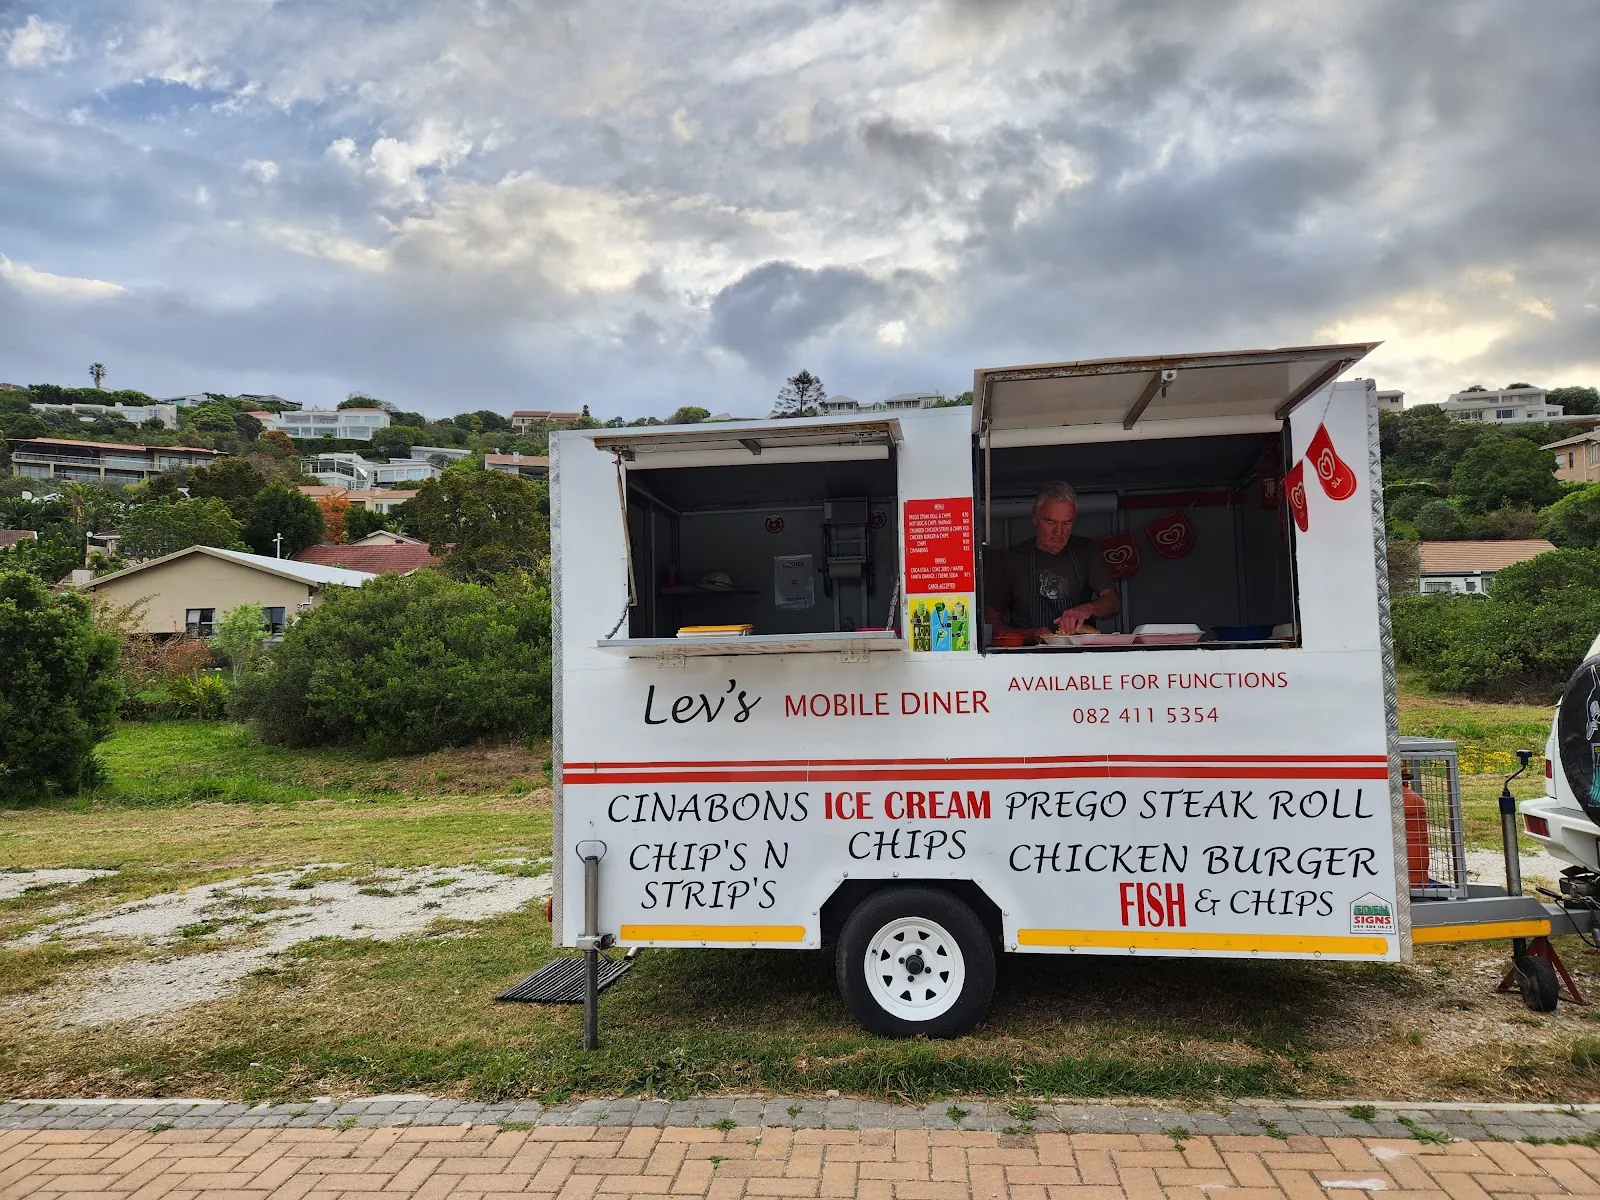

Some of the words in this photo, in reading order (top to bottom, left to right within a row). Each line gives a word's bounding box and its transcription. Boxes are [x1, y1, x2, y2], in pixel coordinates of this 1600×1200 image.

[1331, 477, 1342, 488] OLA
[1171, 542, 1184, 551] OLA
[1008, 674, 1113, 692] AVAILABLE
[1121, 674, 1160, 690] FOR
[1168, 672, 1288, 689] FUNCTIONS
[644, 678, 761, 725] Lev's
[785, 693, 889, 717] MOBILE
[901, 690, 990, 715] DINER
[1073, 708, 1110, 724] 082
[1119, 708, 1154, 723] 411
[1166, 707, 1219, 723] 5354
[607, 790, 809, 823] CINABONS
[824, 791, 873, 820] ICE
[884, 790, 991, 820] CREAM
[1006, 790, 1127, 821] PREGO
[1139, 789, 1258, 820] STEAK
[1268, 788, 1374, 820] ROLL
[629, 839, 748, 872] CHIP'S
[764, 839, 789, 869] N
[848, 829, 967, 860] CHIPS
[1008, 842, 1188, 874] CHICKEN
[1202, 845, 1379, 880] BURGER
[640, 876, 777, 910] STRIP'S
[1119, 882, 1188, 927] FISH
[1194, 888, 1221, 916] &
[1229, 888, 1334, 917] CHIPS
[1354, 905, 1389, 915] EDEN
[1354, 916, 1391, 924] SIGNS
